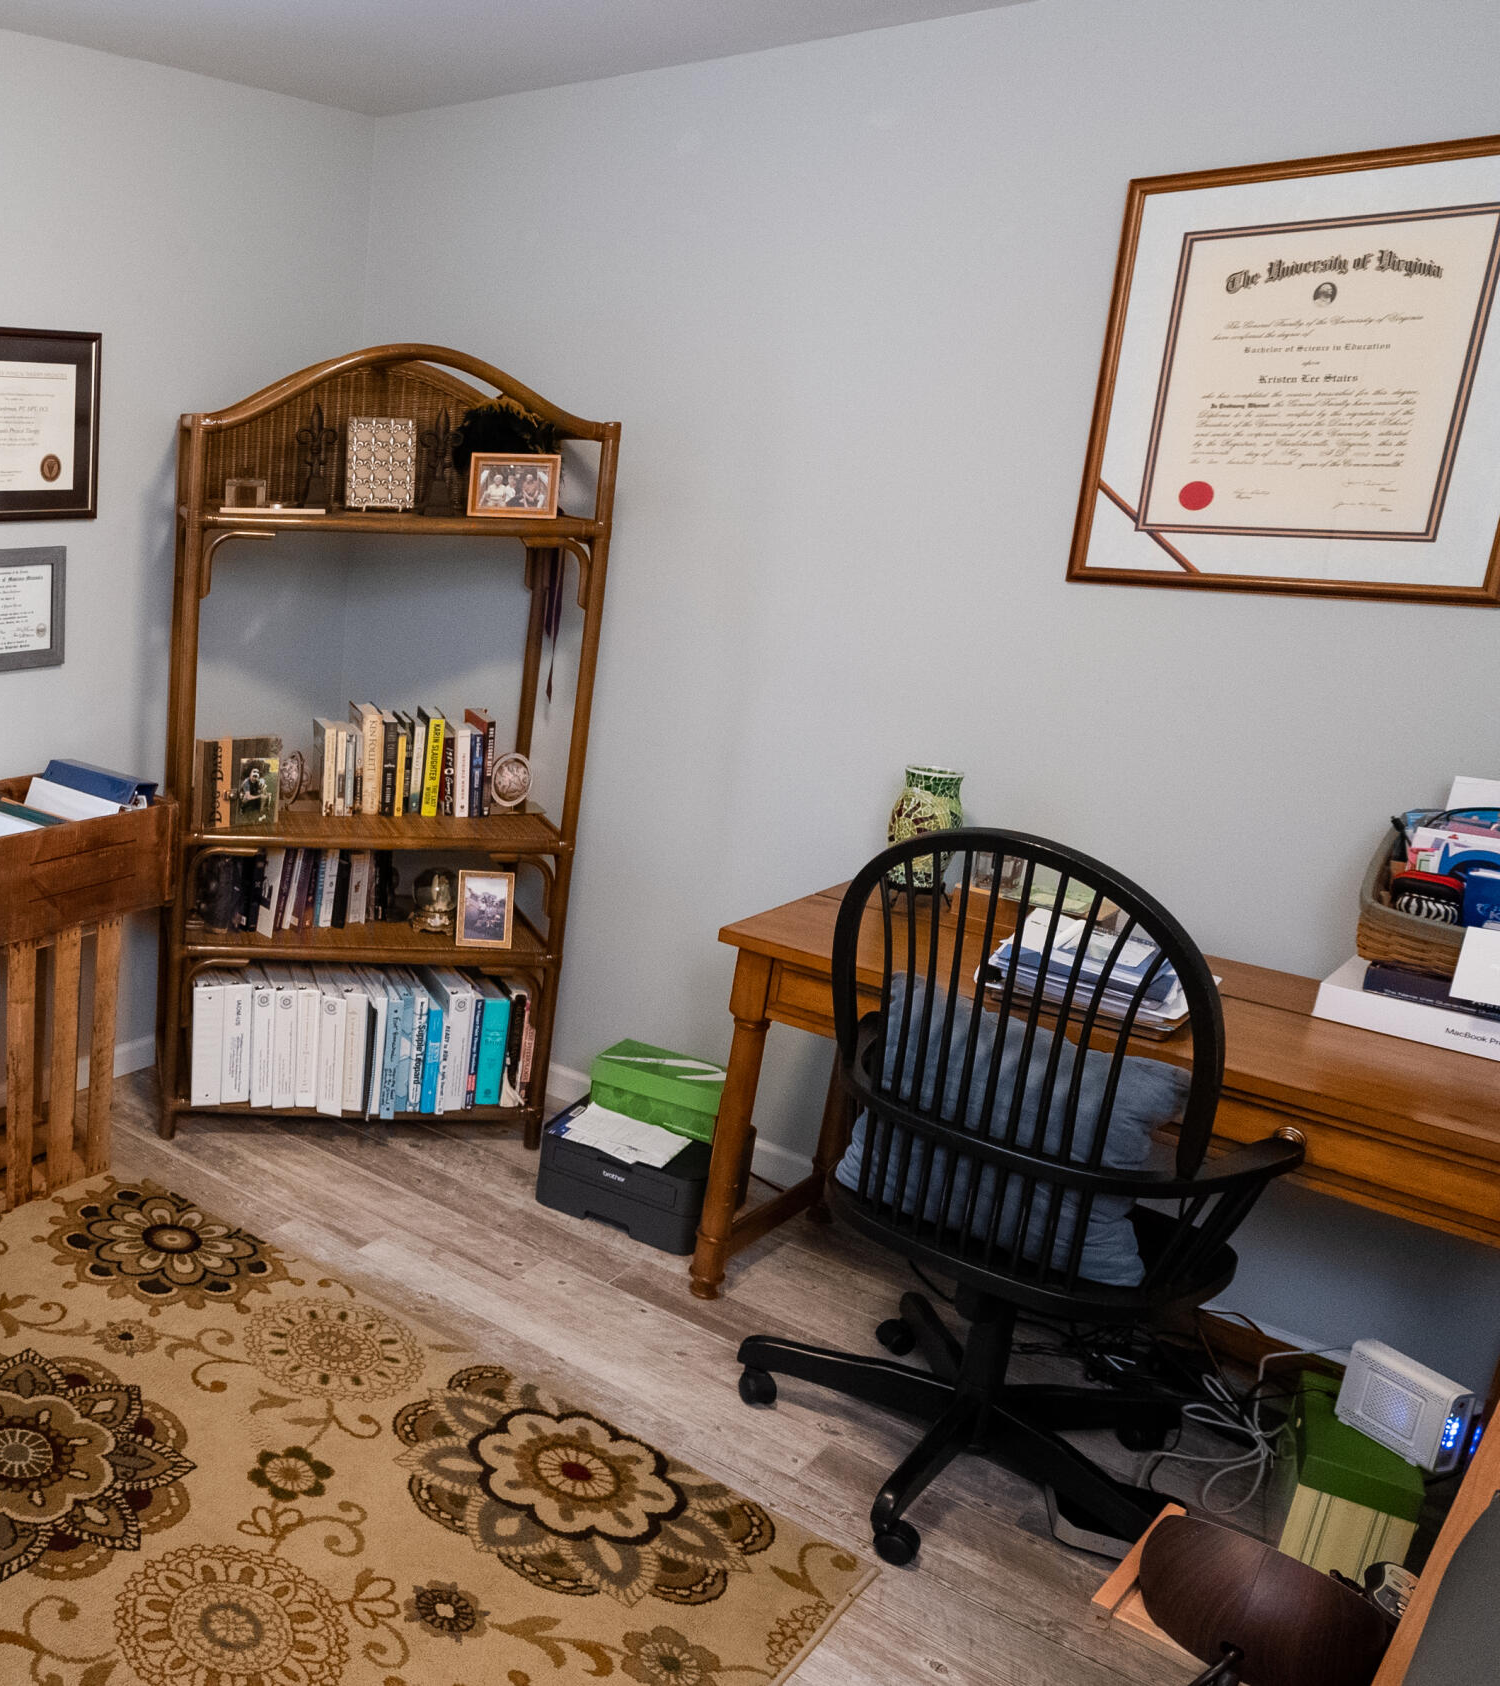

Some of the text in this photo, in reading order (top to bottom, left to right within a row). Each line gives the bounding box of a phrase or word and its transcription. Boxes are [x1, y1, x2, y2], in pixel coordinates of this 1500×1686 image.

[1225, 250, 1443, 294] The University of Virginia
[1344, 343, 1391, 351] Education
[1258, 373, 1358, 384] Kristen Lee Stairs
[367, 720, 378, 771] KEN FOLLETT
[429, 744, 439, 781] SLAUGHTER
[209, 746, 223, 822] DOG DAYS
[415, 1025, 426, 1052] Supple
[1444, 1027, 1487, 1043] MacBook
[412, 1053, 423, 1085] Leopard
[602, 1170, 626, 1183] brother
